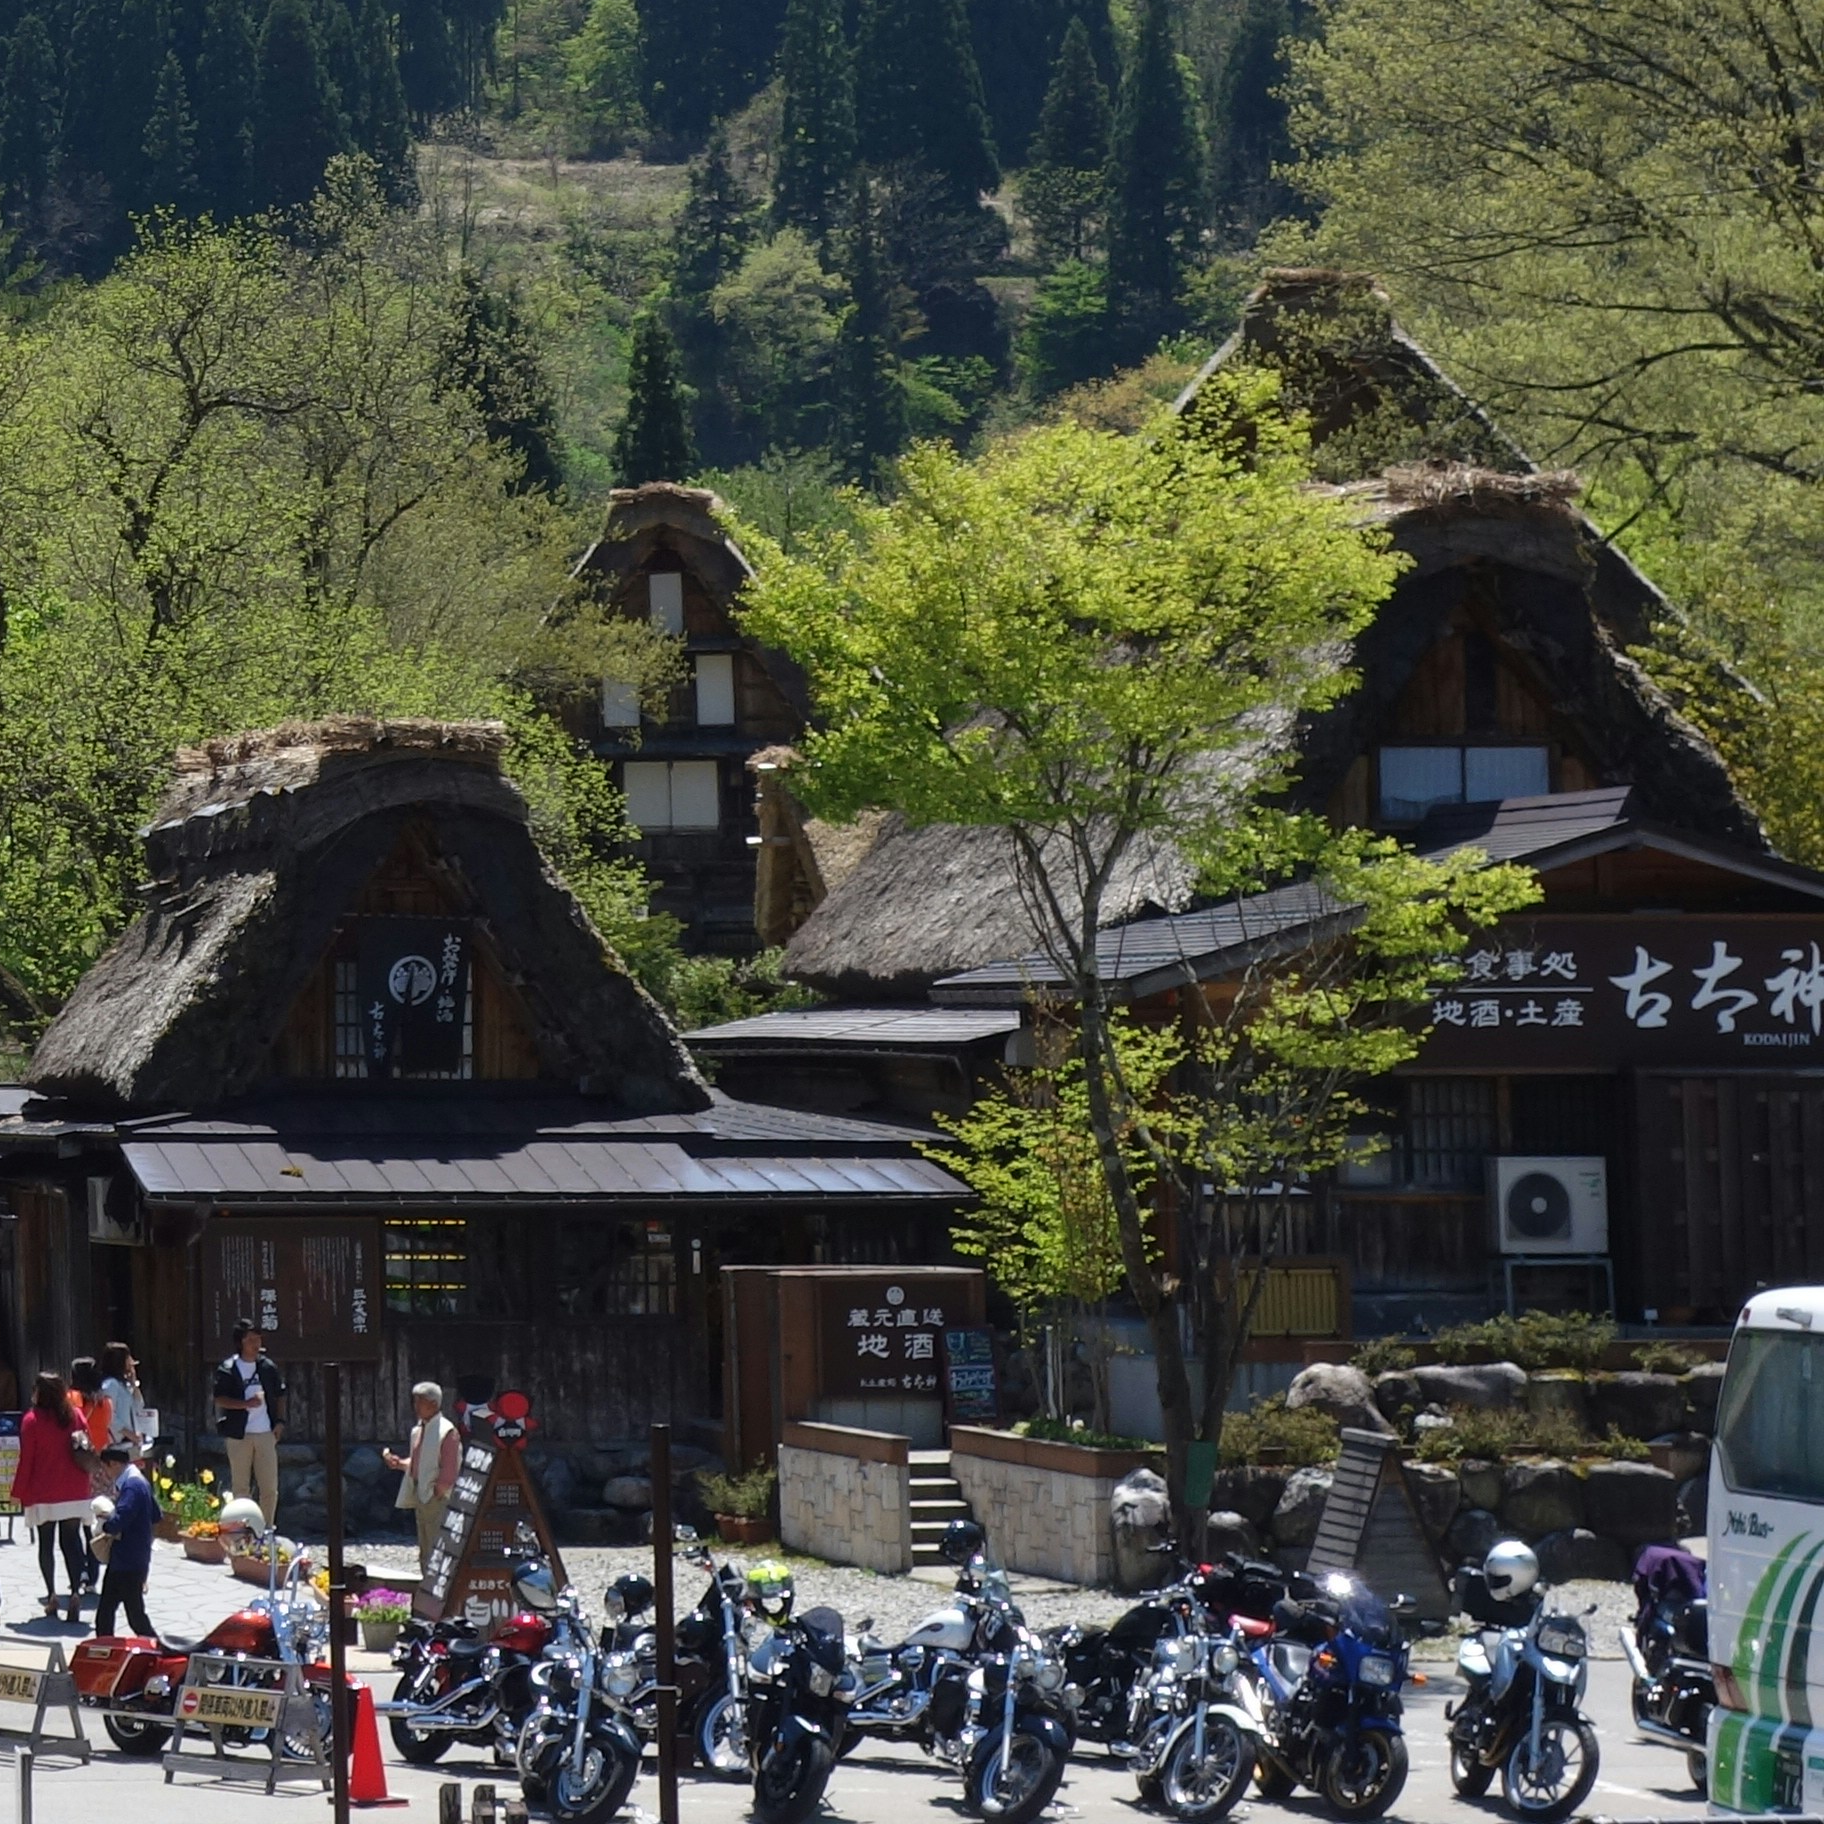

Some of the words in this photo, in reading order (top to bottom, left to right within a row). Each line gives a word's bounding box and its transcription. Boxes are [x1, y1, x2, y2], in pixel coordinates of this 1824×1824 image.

[1432, 998, 1585, 1028] 地酒・土産
[1744, 1033, 1811, 1048] KODAIJIN
[847, 1308, 945, 1327] 蔵元直送
[857, 1333, 935, 1360] 地酒
